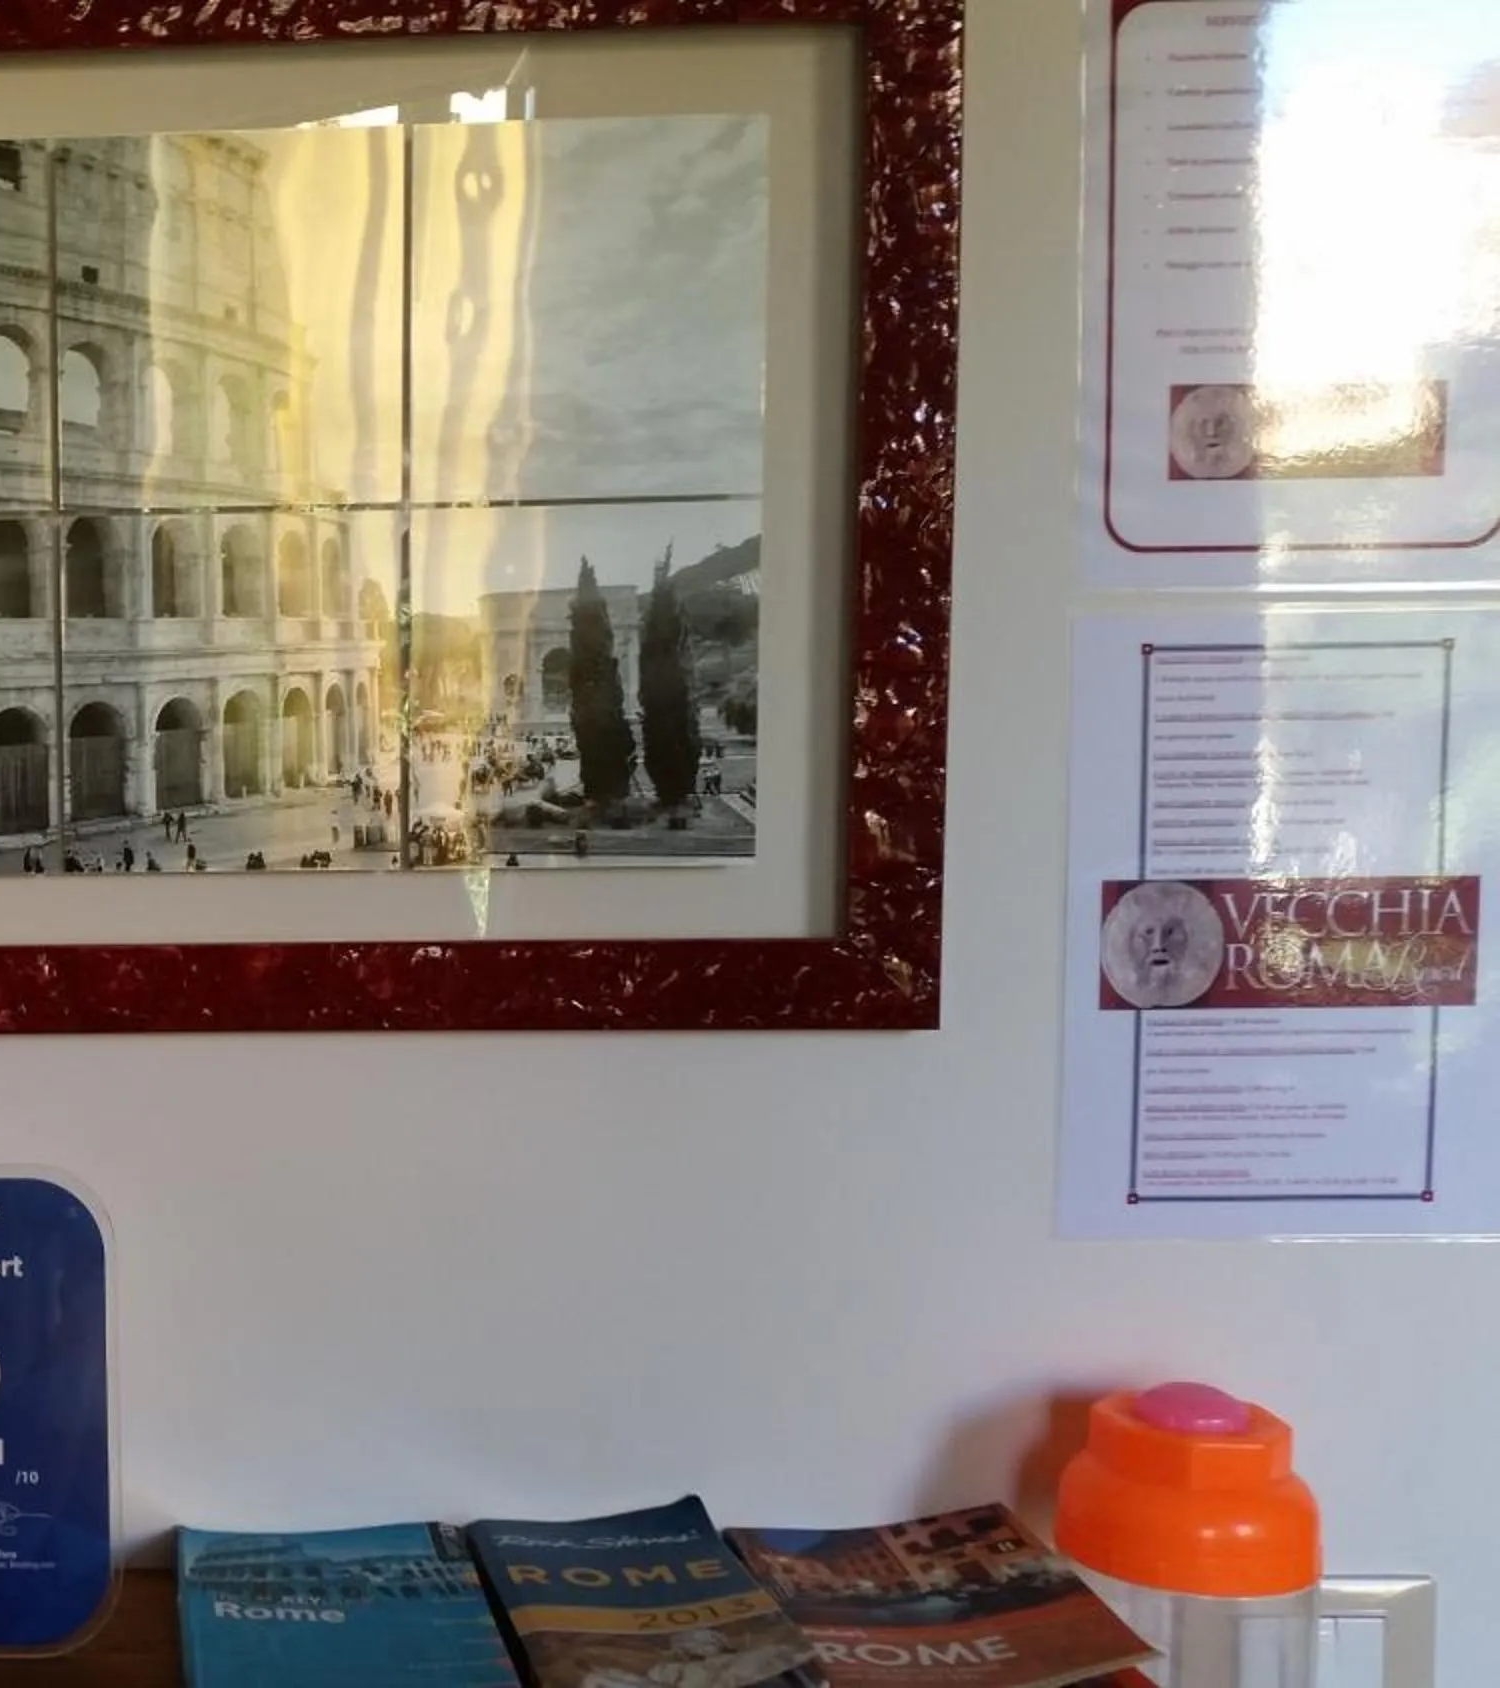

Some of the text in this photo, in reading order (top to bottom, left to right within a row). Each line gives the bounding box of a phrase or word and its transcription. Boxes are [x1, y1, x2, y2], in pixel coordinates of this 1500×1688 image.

[1220, 889, 1473, 941] VECCHIA
[15, 1471, 39, 1485] /10
[507, 1559, 729, 1587] ROME
[214, 1601, 345, 1623] Rome
[811, 1636, 1018, 1667] ROME
